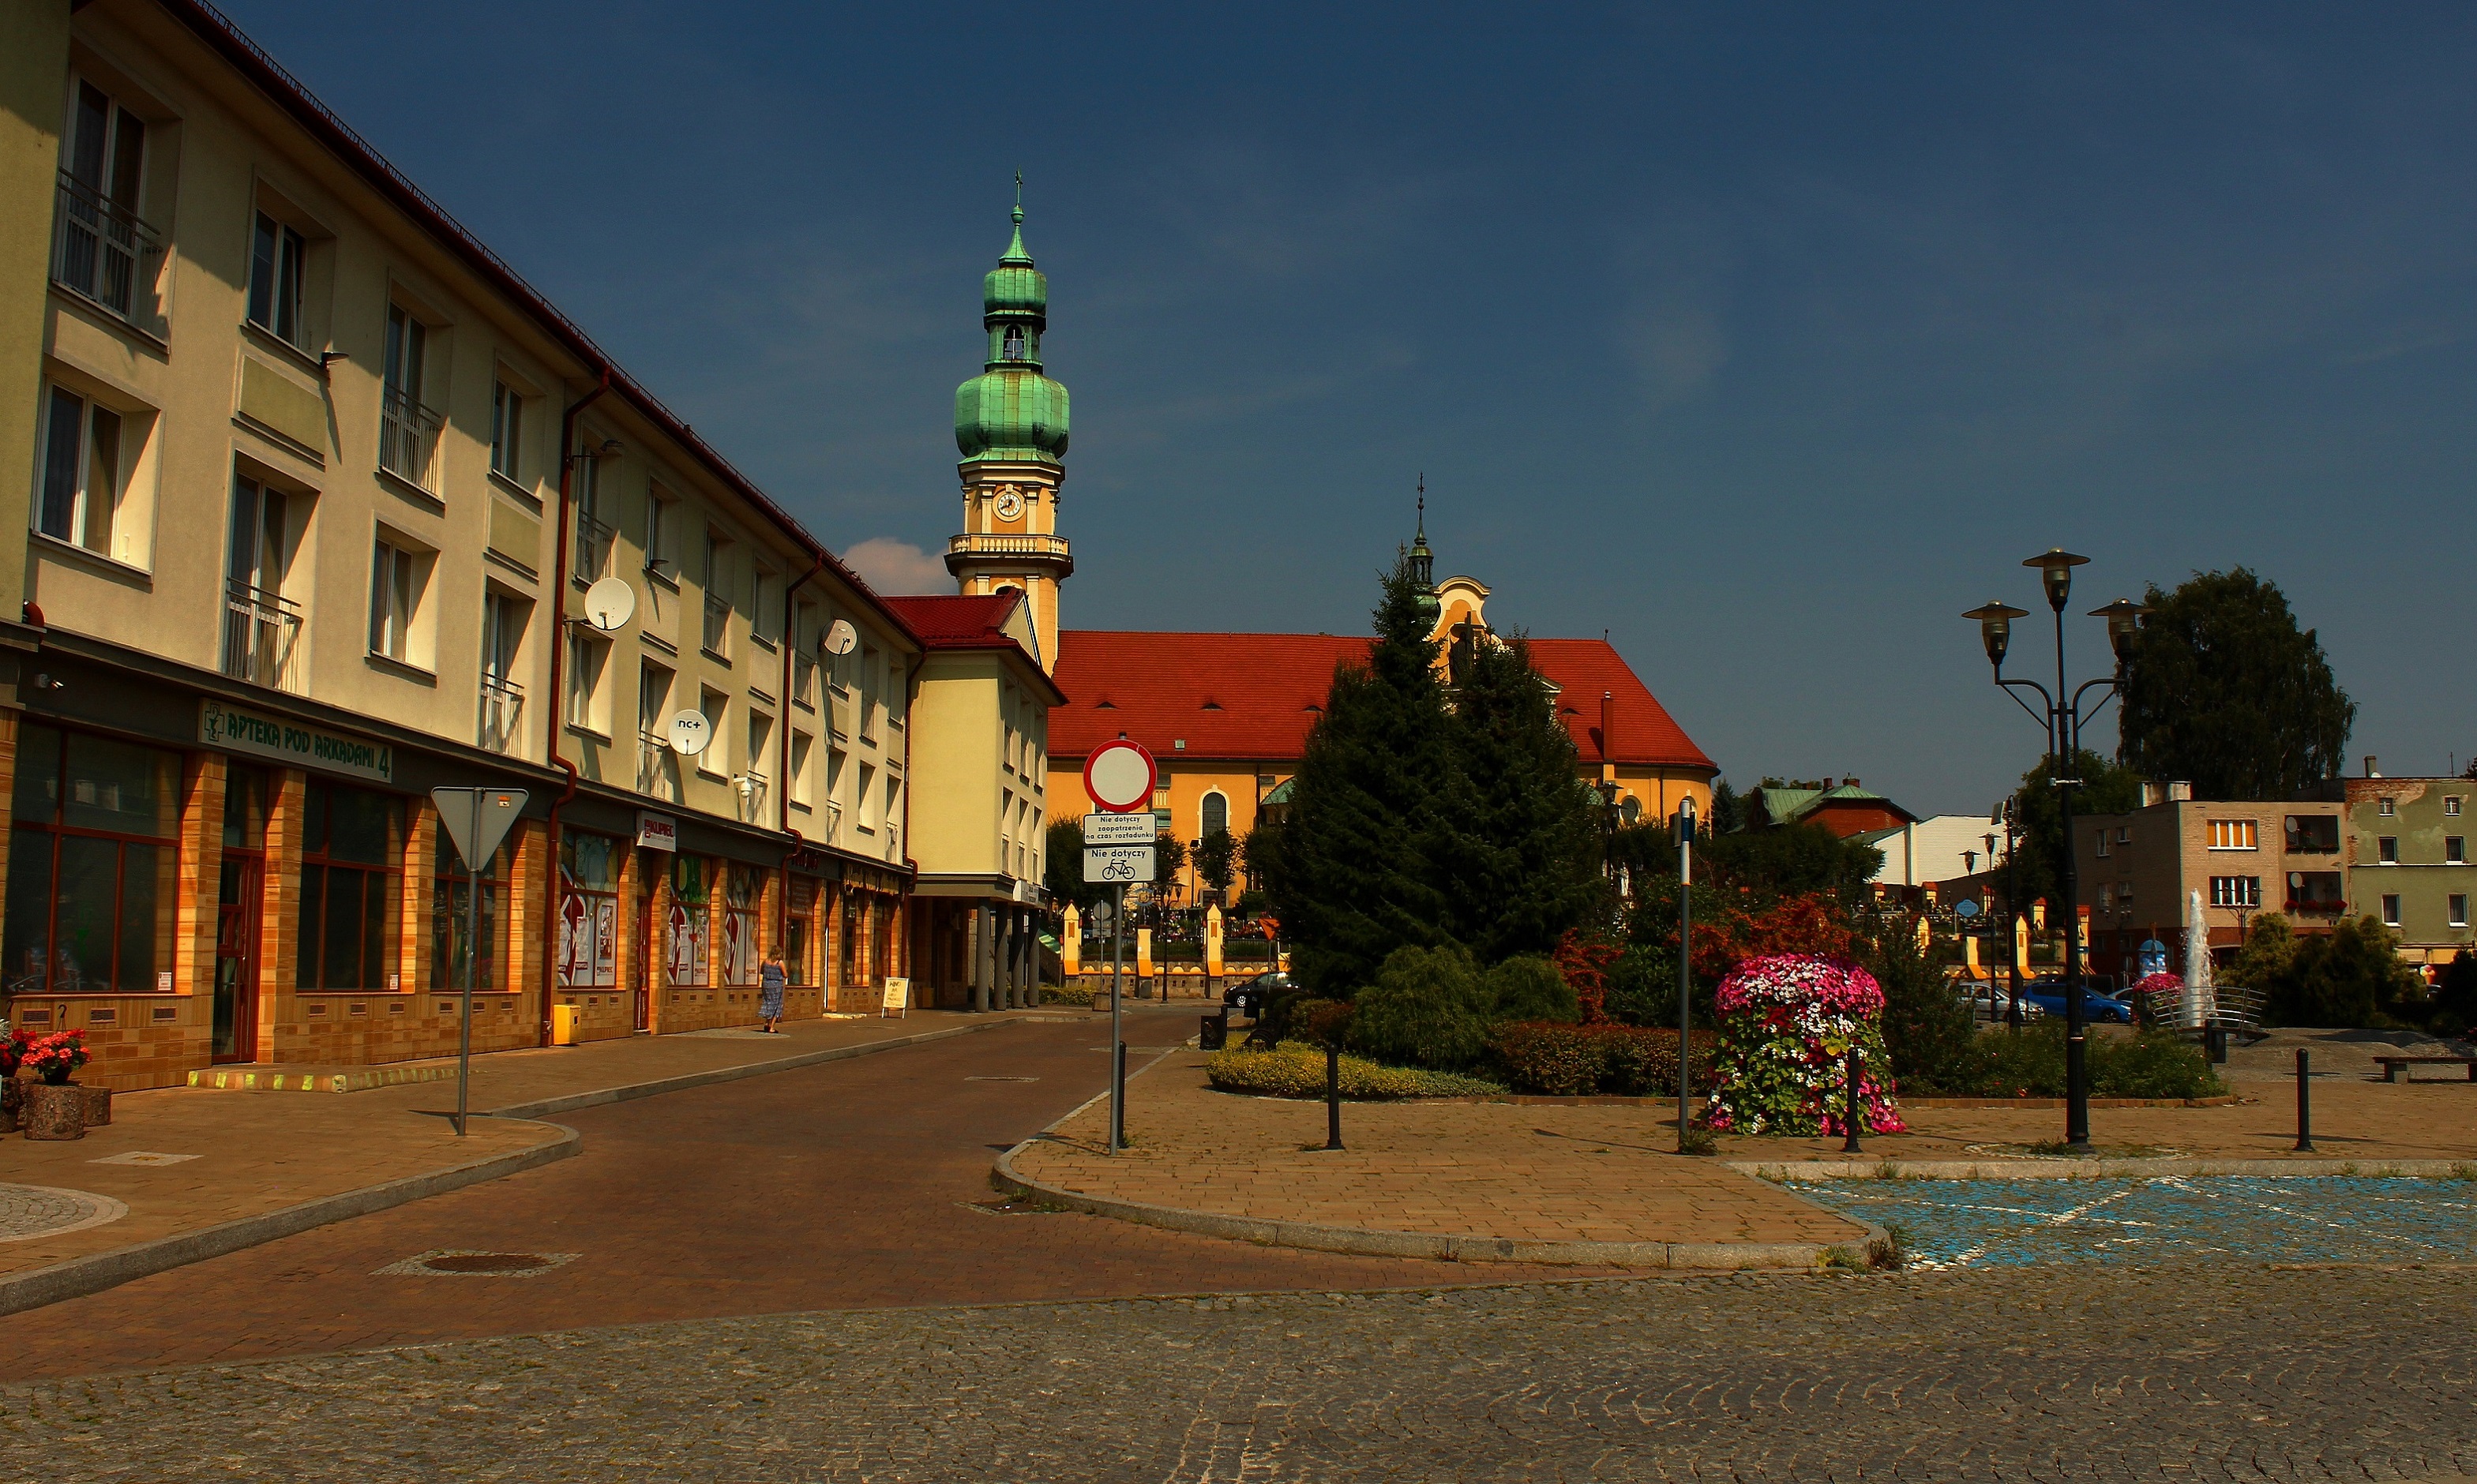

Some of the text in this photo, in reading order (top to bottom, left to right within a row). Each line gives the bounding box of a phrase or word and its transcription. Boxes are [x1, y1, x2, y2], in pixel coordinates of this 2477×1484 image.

[678, 720, 701, 729] nc+
[227, 712, 389, 778] APTEKA POD ARKADAMI 4
[1111, 849, 1147, 859] dotyczy
